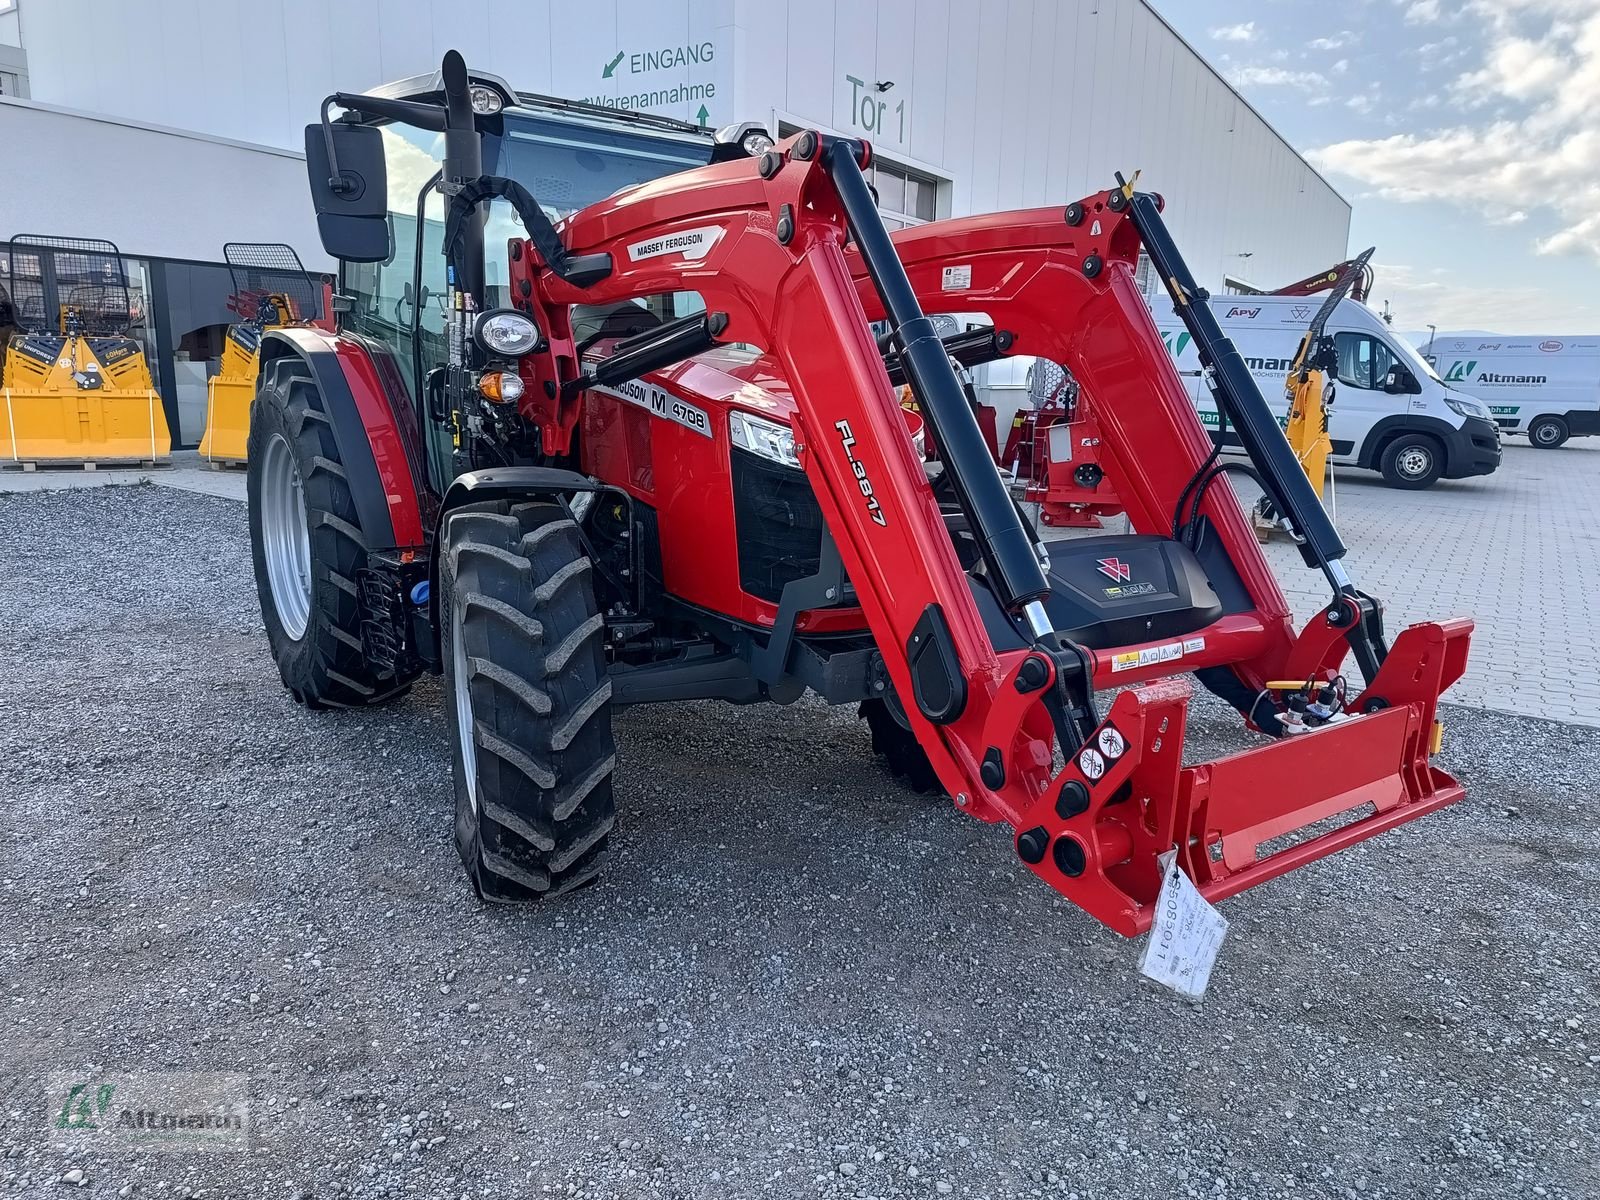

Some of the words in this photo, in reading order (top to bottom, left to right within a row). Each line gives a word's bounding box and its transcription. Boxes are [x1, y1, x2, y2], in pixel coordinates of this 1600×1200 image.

[630, 42, 714, 74] EINGANG
[590, 83, 715, 110] Warenannahme
[846, 74, 887, 135] Tor
[896, 99, 904, 144] 1
[637, 242, 664, 256] MASSEY
[665, 233, 703, 249] FERGUSON
[23, 344, 55, 361] UNIFOREST
[1477, 373, 1547, 384] Altmann
[613, 381, 648, 403] GUSON
[651, 389, 666, 415] M
[672, 402, 705, 429] 4708
[834, 418, 888, 528] FL.3817
